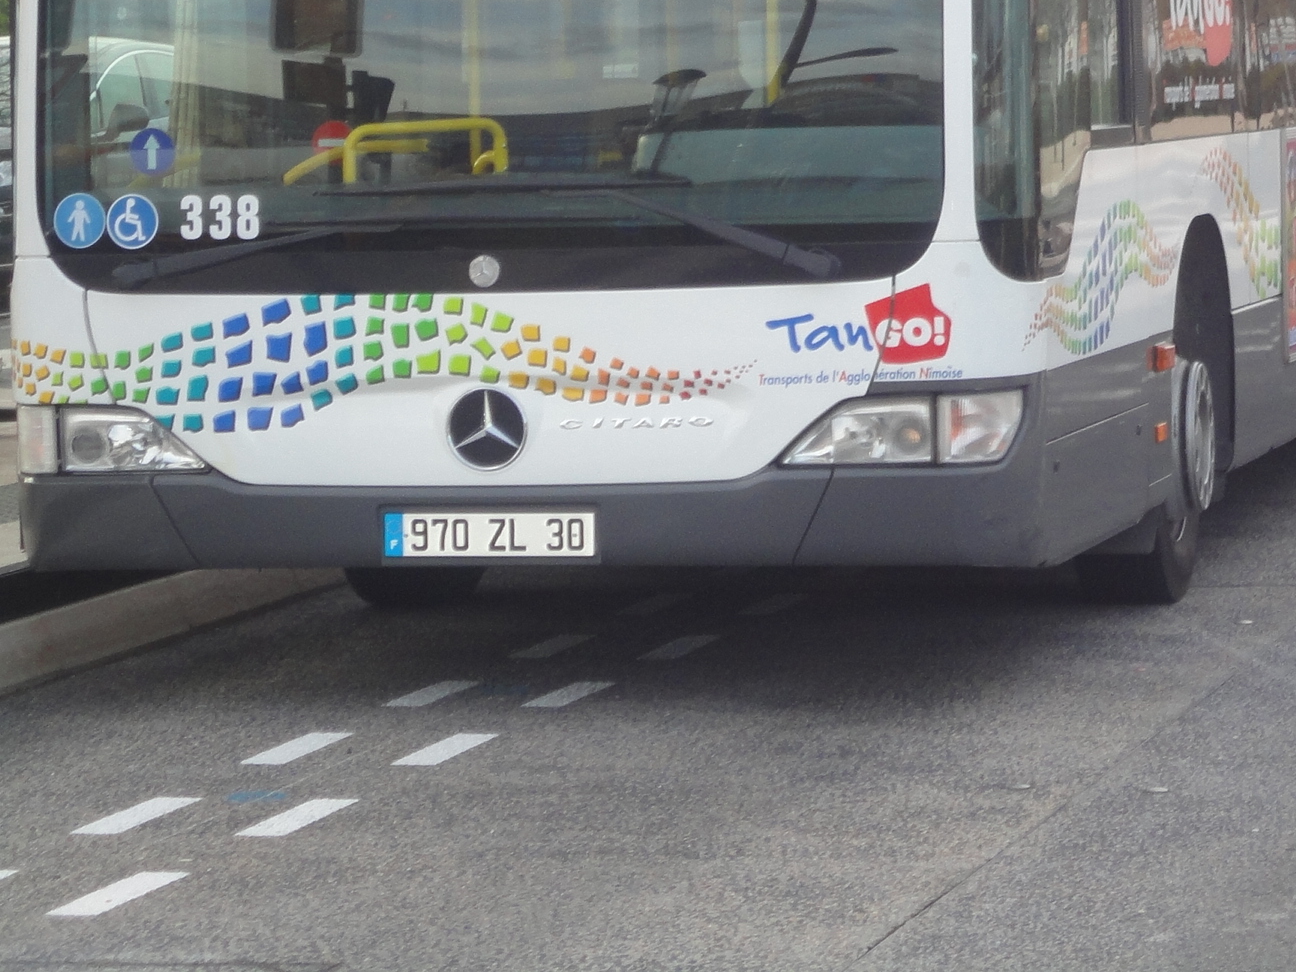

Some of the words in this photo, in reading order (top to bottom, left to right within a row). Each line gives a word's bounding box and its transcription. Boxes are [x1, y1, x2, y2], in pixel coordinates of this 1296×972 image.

[180, 194, 260, 240] 338
[759, 372, 813, 388] Transports
[816, 370, 829, 383] de
[559, 415, 715, 430] CITARO
[409, 518, 470, 553] 970
[487, 518, 528, 553] ZL
[545, 517, 586, 552] 30
